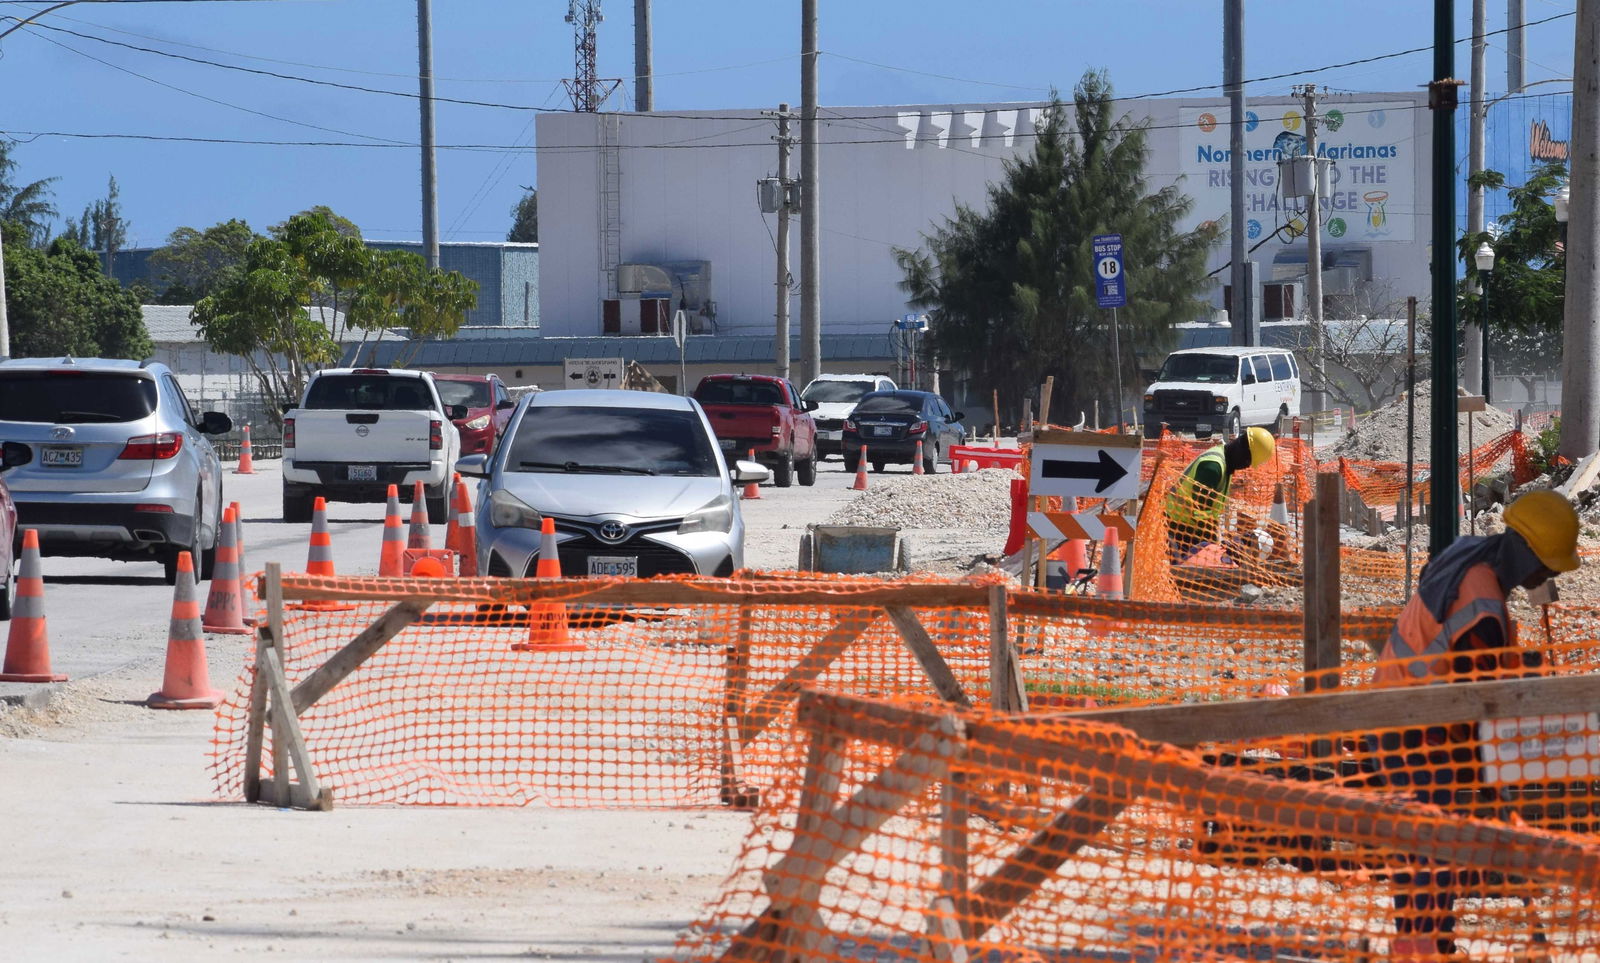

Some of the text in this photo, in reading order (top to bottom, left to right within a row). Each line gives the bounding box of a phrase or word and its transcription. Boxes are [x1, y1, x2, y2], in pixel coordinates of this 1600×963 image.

[1530, 118, 1568, 163] Welcome
[1198, 145, 1282, 163] Norern
[1209, 168, 1275, 187] RING
[1349, 165, 1387, 184] THE
[1094, 244, 1122, 253] BUS STOP
[1102, 261, 1116, 274] 18
[42, 451, 81, 463] ACZ 435
[616, 562, 635, 576] 595
